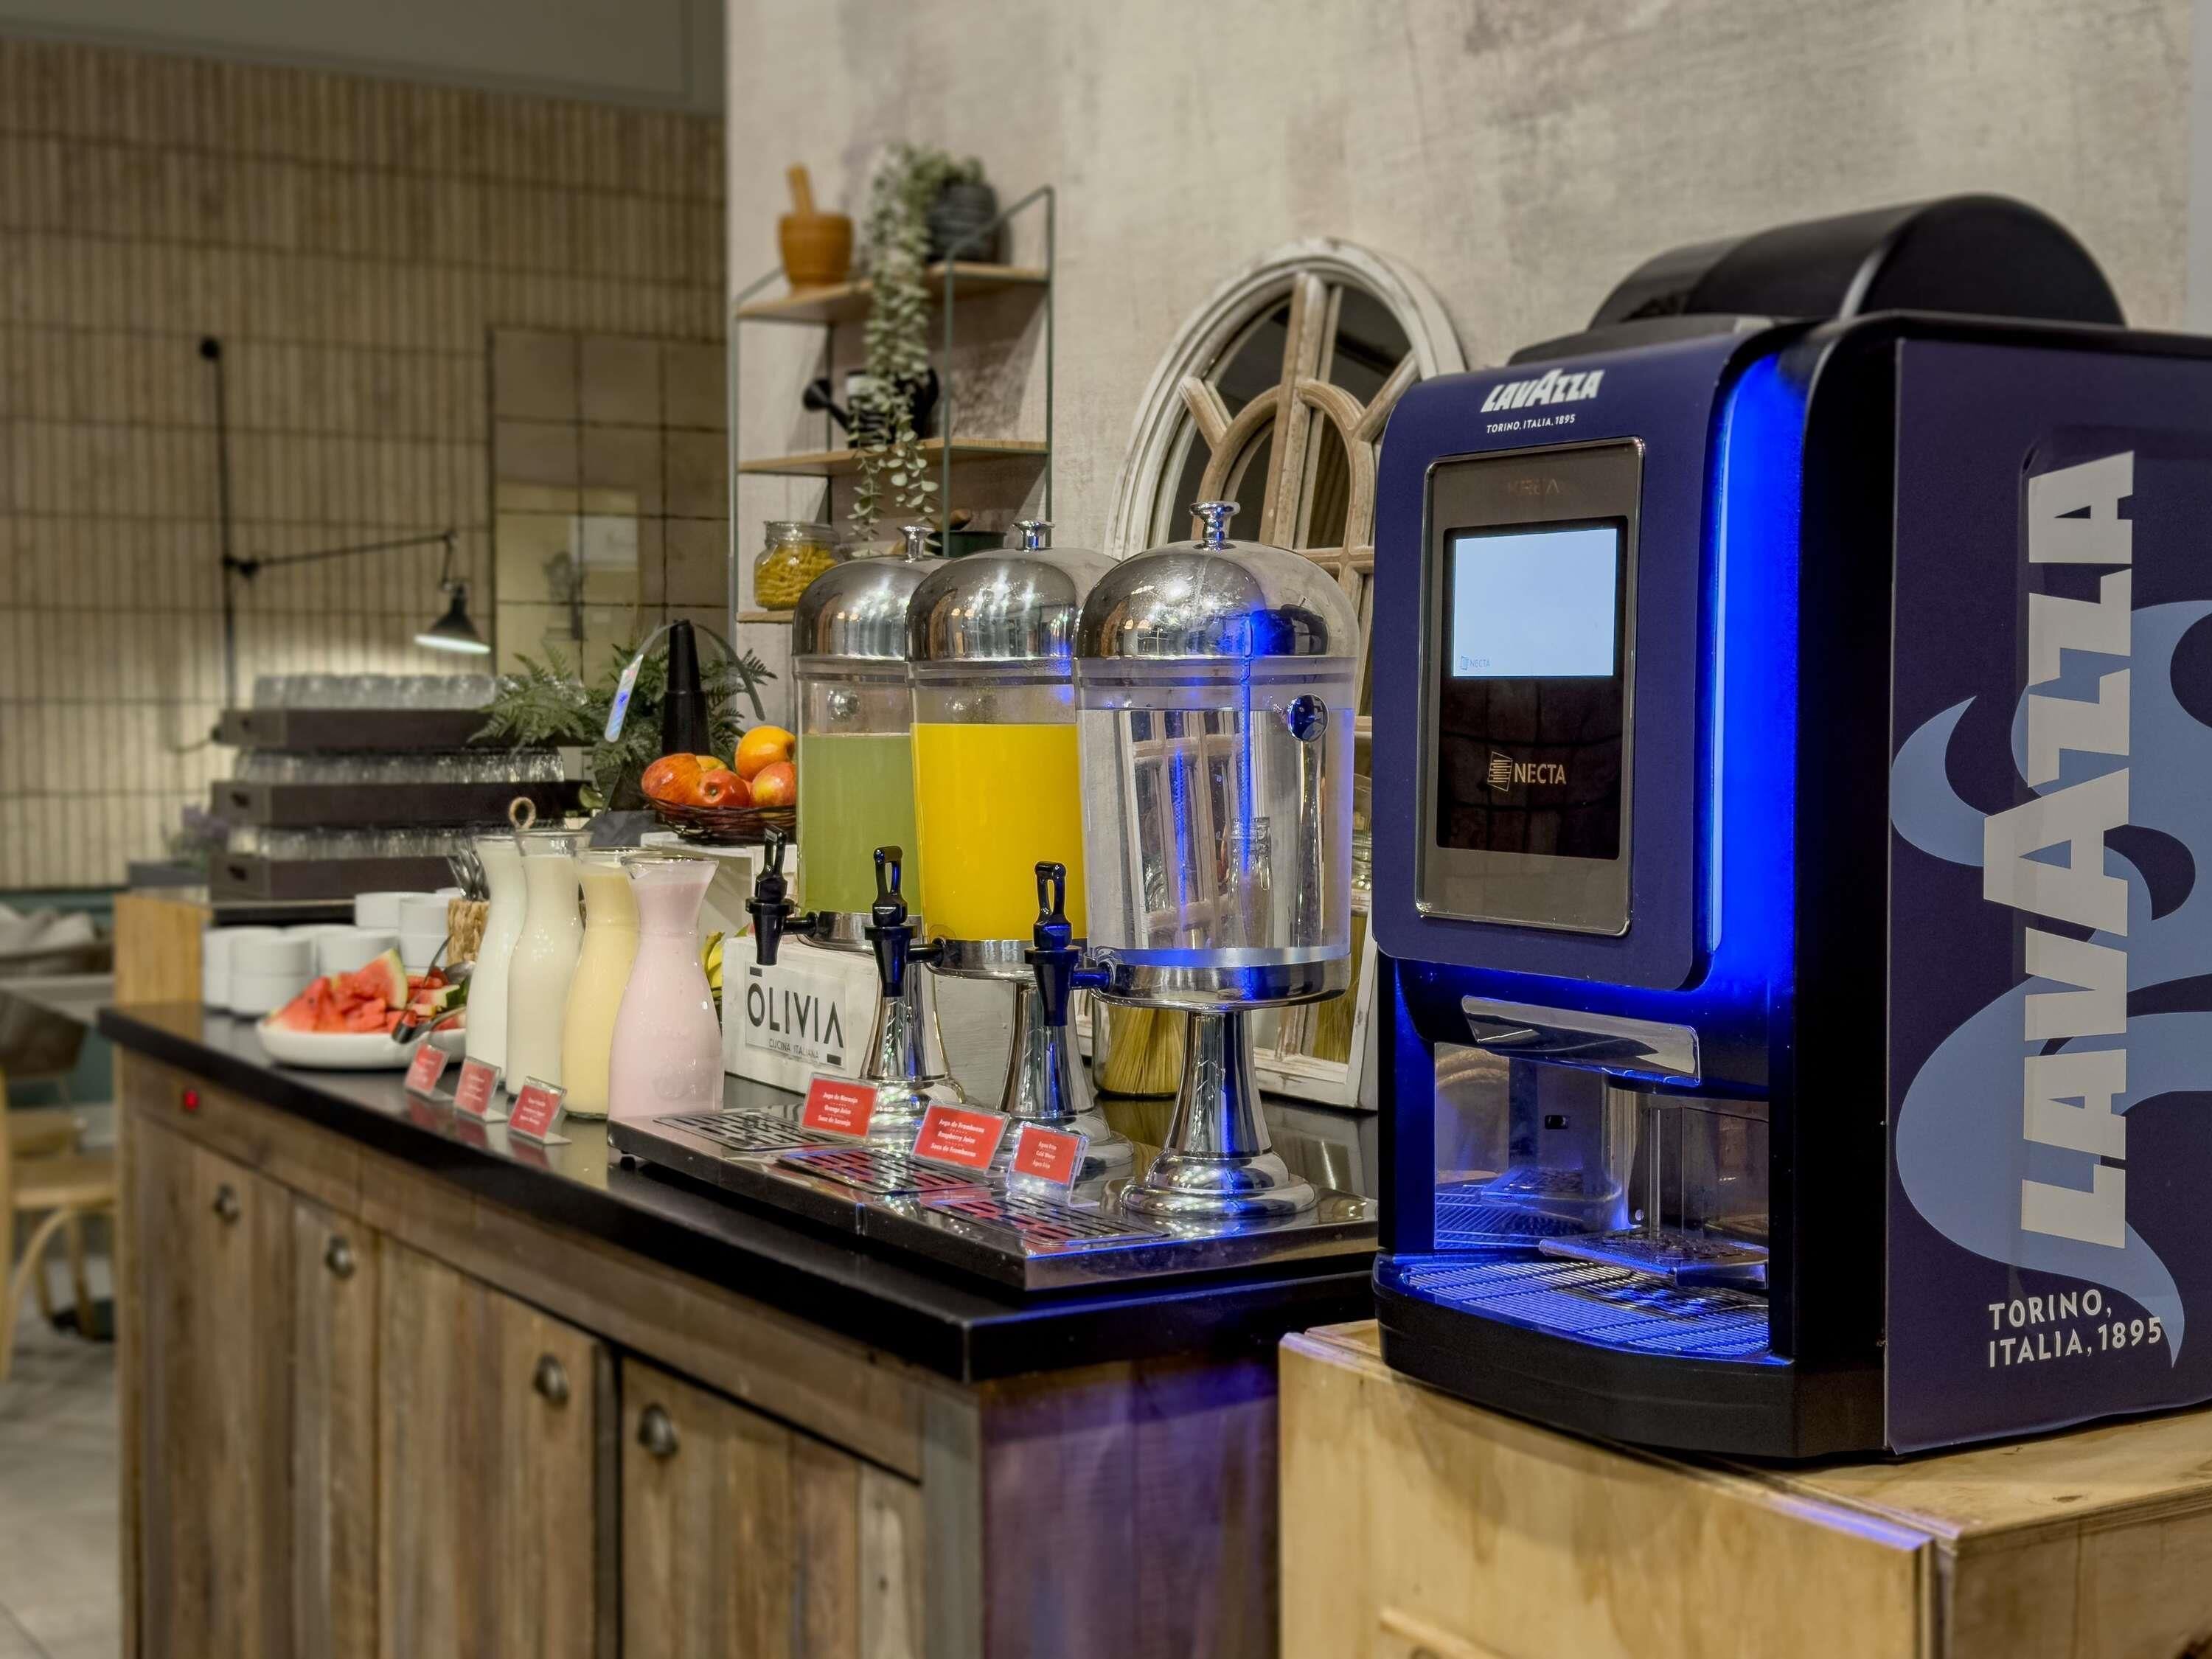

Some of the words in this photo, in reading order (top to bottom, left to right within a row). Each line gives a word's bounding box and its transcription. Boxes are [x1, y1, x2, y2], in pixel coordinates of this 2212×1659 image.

[1480, 368, 1605, 413] LAVAZZA
[1555, 414, 1576, 425] 1895
[1514, 762, 1567, 785] NECTA
[1983, 450, 2135, 1248] LAVAZZA
[769, 1038, 790, 1051] CUCINA
[1989, 1289, 2111, 1330] TORINO,
[1989, 1328, 2093, 1368] ITALIA,
[2098, 1316, 2162, 1351] 1895
